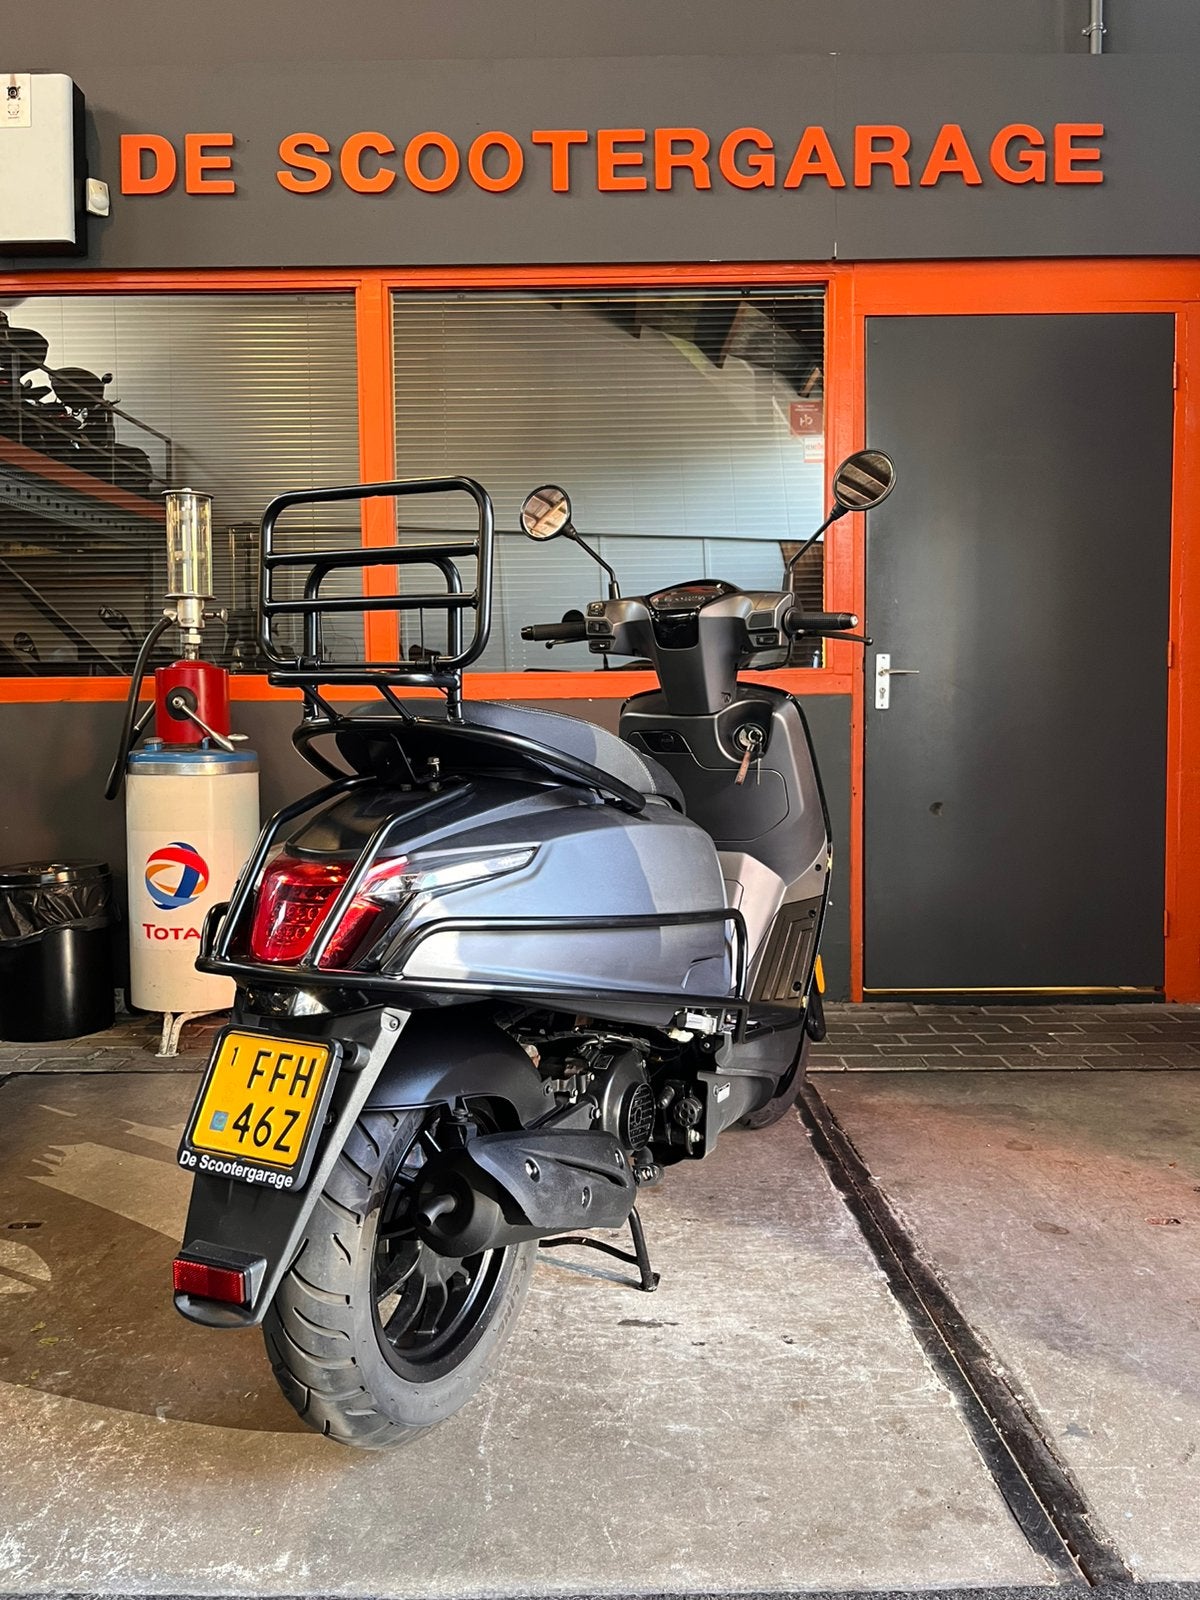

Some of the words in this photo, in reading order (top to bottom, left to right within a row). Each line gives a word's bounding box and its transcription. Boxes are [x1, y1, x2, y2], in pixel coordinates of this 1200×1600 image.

[120, 133, 236, 195] DE
[276, 123, 1105, 194] SCOOTERGARAGE
[142, 923, 201, 940] TOTA
[230, 1046, 240, 1067] 1
[247, 1050, 317, 1098] FFH
[232, 1102, 302, 1153] 46Z
[179, 1150, 197, 1167] De
[199, 1154, 294, 1189] Scootergarage
